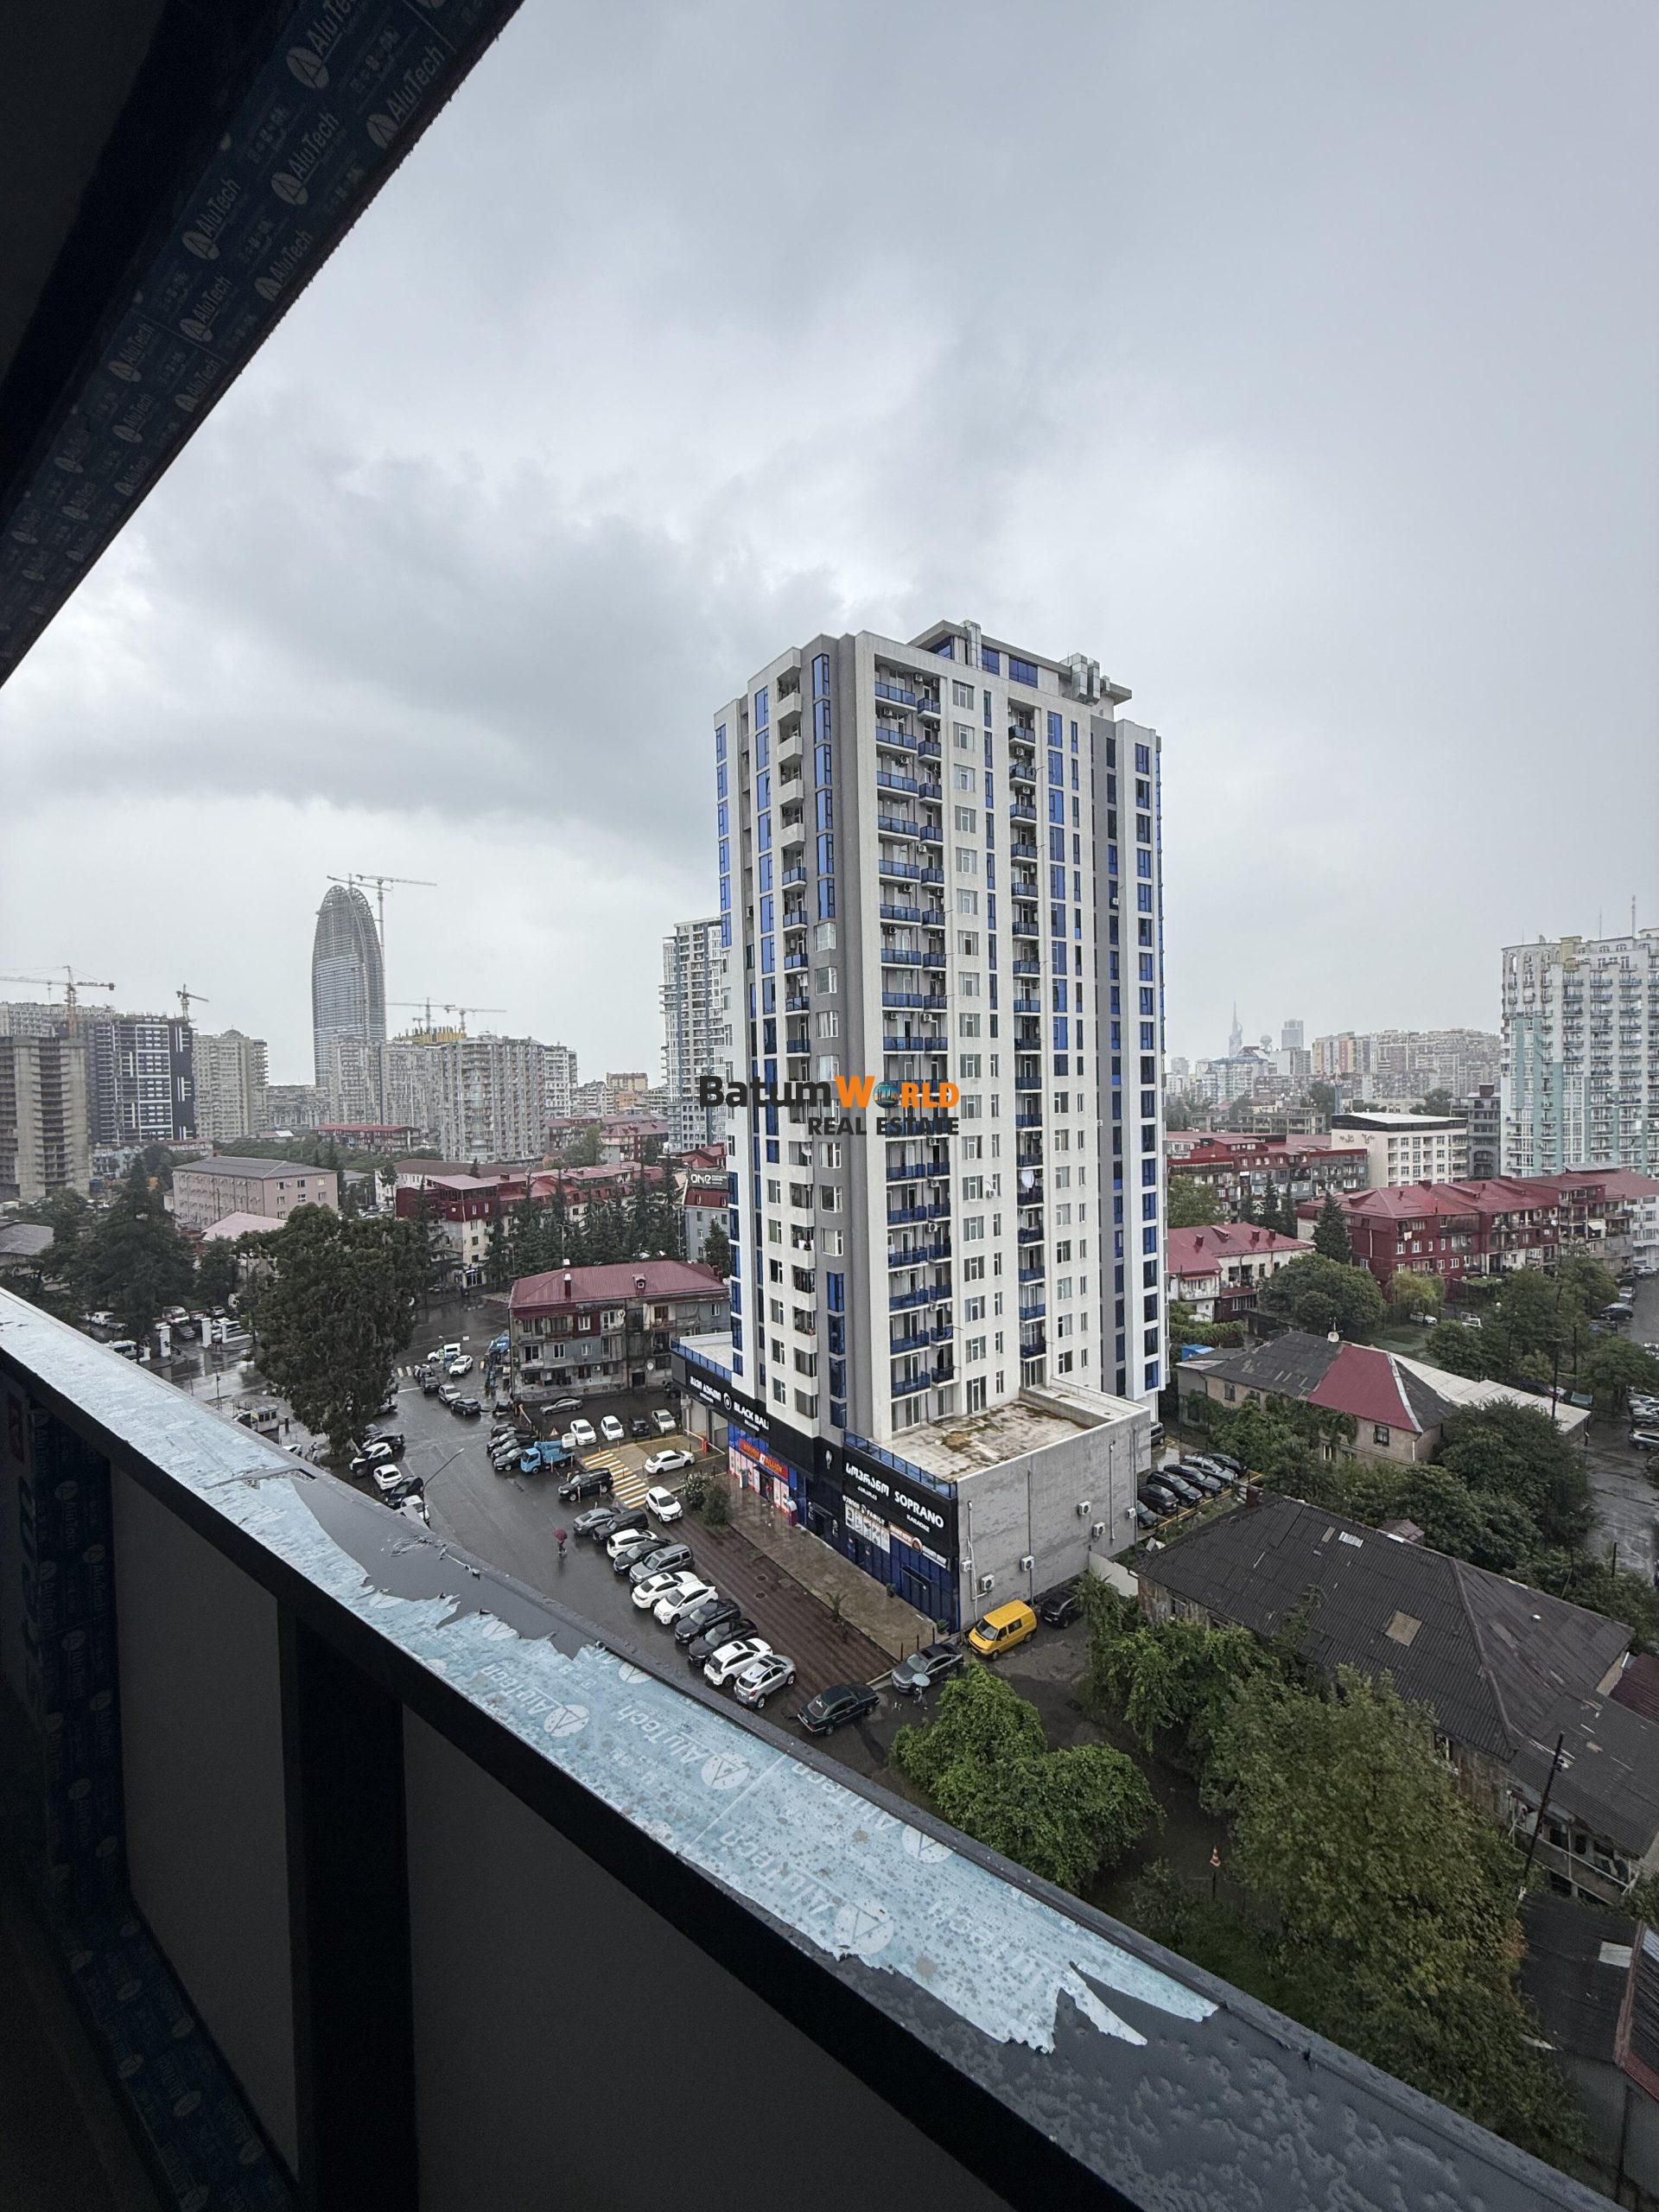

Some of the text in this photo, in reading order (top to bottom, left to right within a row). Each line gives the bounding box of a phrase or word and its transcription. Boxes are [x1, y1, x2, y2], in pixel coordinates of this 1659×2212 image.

[386, 46, 446, 122] AluTech
[288, 111, 340, 181] AluTech
[194, 178, 242, 239] AluTech
[268, 229, 314, 283] AluTech
[191, 276, 233, 325] AluTech
[118, 322, 156, 365] AluTech
[187, 358, 222, 400] AluTech
[122, 392, 155, 430] AluTech
[734, 1402, 753, 1421] BLACK
[754, 1413, 769, 1430] BALL
[846, 1462, 890, 1497] სოპრანო
[894, 1491, 944, 1528] SOPRANO
[480, 1661, 559, 1716] AluTech
[617, 1704, 705, 1764] AluTech
[719, 1827, 836, 1916] AluTech
